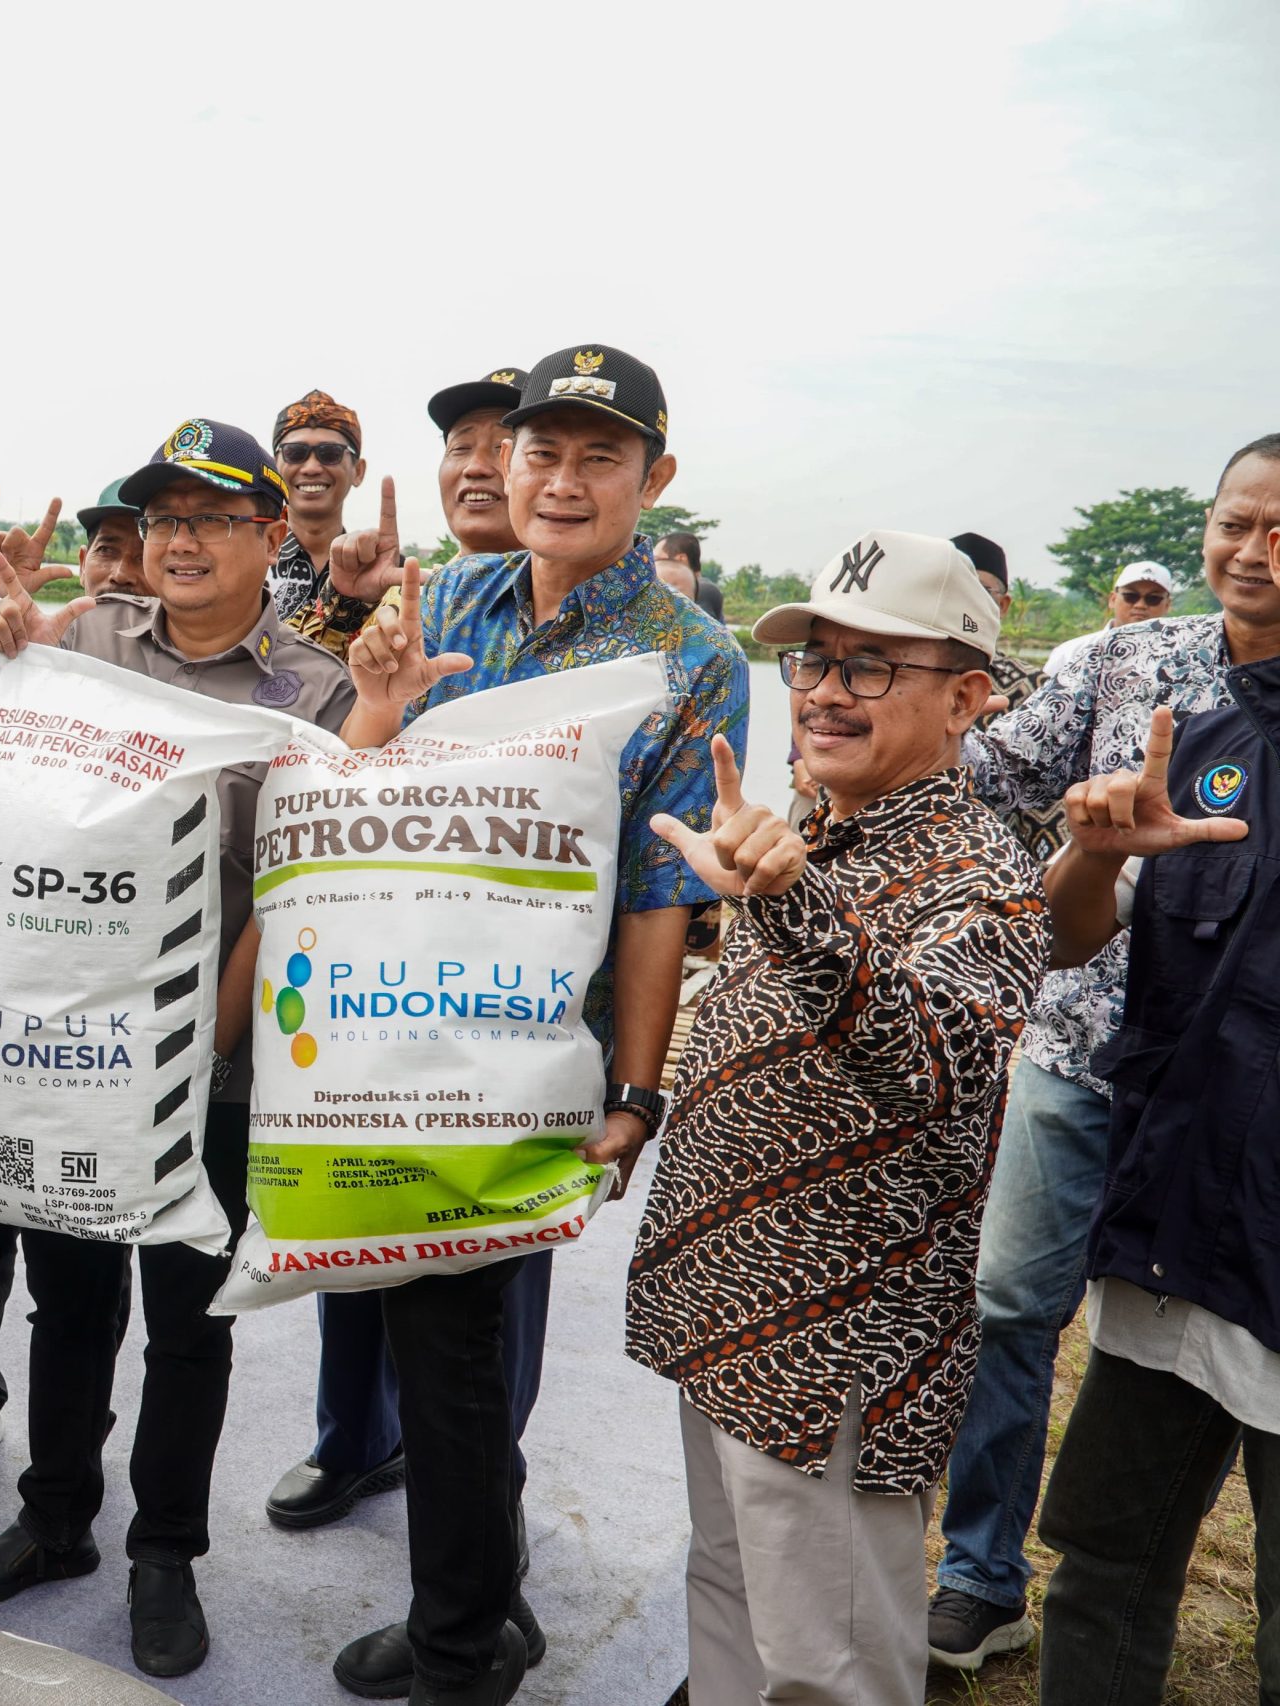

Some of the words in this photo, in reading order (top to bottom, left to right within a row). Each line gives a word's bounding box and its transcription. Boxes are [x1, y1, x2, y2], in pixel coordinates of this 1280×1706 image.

[830, 540, 886, 593] NY
[69, 719, 185, 764] PEMERINTAH
[40, 735, 169, 782] PENGAWASAN
[270, 754, 309, 768] MOR
[274, 786, 368, 819] PUPUK
[378, 785, 541, 810] ORGANIK
[255, 815, 592, 873] PETROGANIK
[12, 864, 137, 904] SP-36
[283, 897, 297, 908] 15%
[306, 894, 327, 906] C/N
[329, 892, 360, 903] Rasio
[379, 892, 394, 901] 25
[416, 889, 434, 901] pH
[445, 890, 452, 899] 4
[463, 890, 470, 901] 9
[487, 892, 523, 906] Kadar
[526, 898, 546, 910] Air
[555, 901, 562, 910] 8
[572, 904, 593, 914] 25%
[7, 913, 16, 927] S
[20, 912, 93, 937] (SULFUR)
[108, 920, 130, 936] 5%
[330, 961, 575, 997] PUPUK
[330, 991, 567, 1025] INDONESIA
[331, 1030, 439, 1041] HOLDING
[39, 1077, 132, 1088] COMPANY
[314, 1091, 419, 1104] Diproduksi
[426, 1090, 471, 1102] oleh
[297, 1113, 408, 1128] INDONESIA
[415, 1112, 538, 1131] (PERSERO)
[543, 1110, 595, 1127] GROUP
[61, 1156, 97, 1178] SNI
[261, 1156, 280, 1165] EDAR
[332, 1159, 366, 1167] APRIL
[368, 1159, 395, 1167] 2029
[266, 1167, 303, 1175] PRODUSEN
[332, 1171, 373, 1179] GRESIK,
[376, 1167, 438, 1178] INDONESIA
[334, 1173, 425, 1189] 02.01.2024.127
[42, 1185, 116, 1198] 02-3769-2005
[20, 1202, 41, 1214] NPB
[45, 1199, 113, 1212] LSPr-008-IDN
[24, 1212, 62, 1230] BERAT
[268, 1245, 407, 1273] JANGAN
[413, 1214, 587, 1260] DIGANCU
